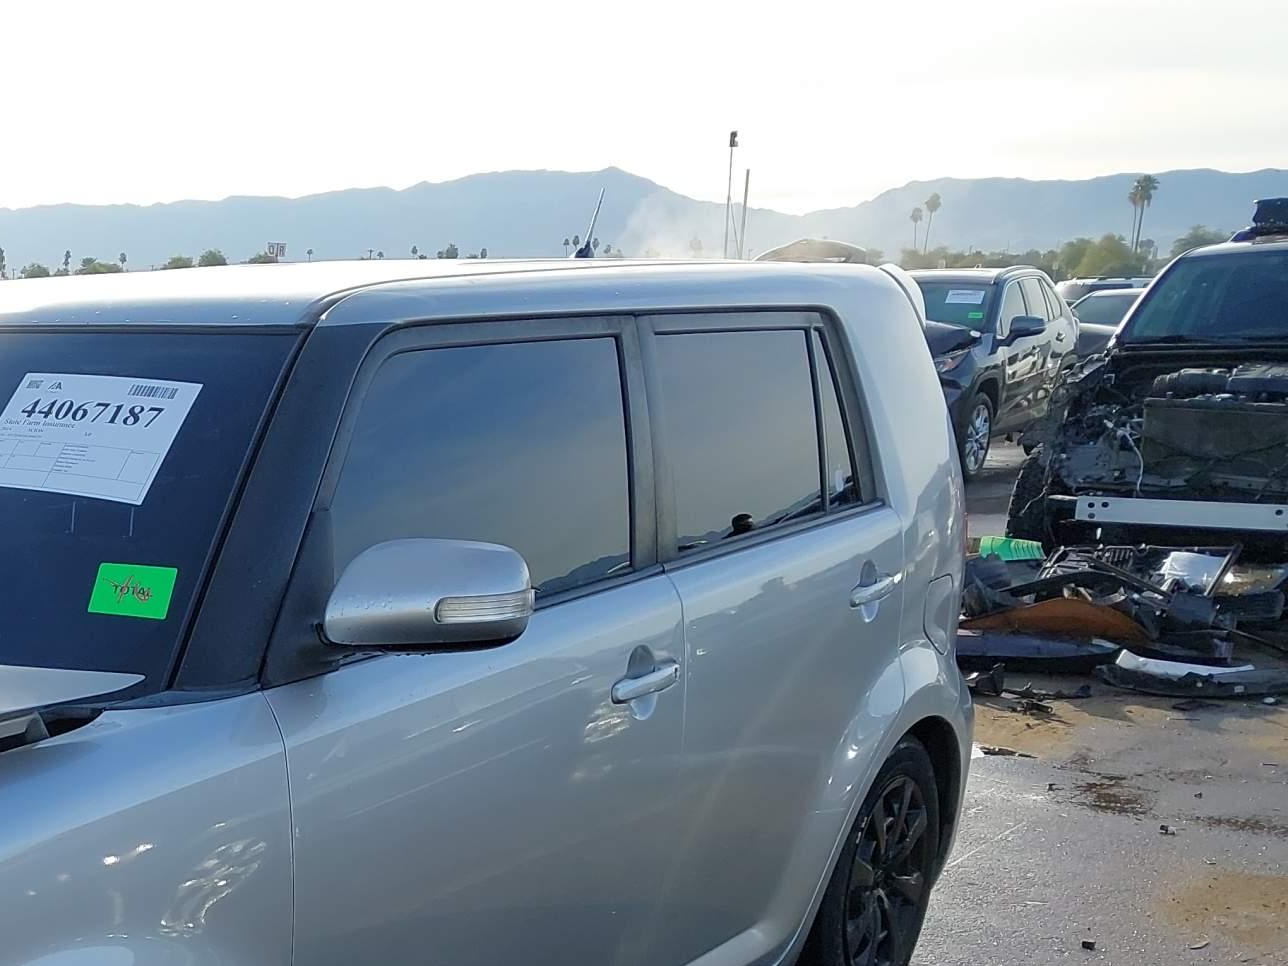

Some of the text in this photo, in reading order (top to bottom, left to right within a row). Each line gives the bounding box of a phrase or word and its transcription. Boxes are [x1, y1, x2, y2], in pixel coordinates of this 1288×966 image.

[21, 398, 165, 428] 44067187
[4, 418, 22, 426] State
[42, 420, 76, 429] Insurance
